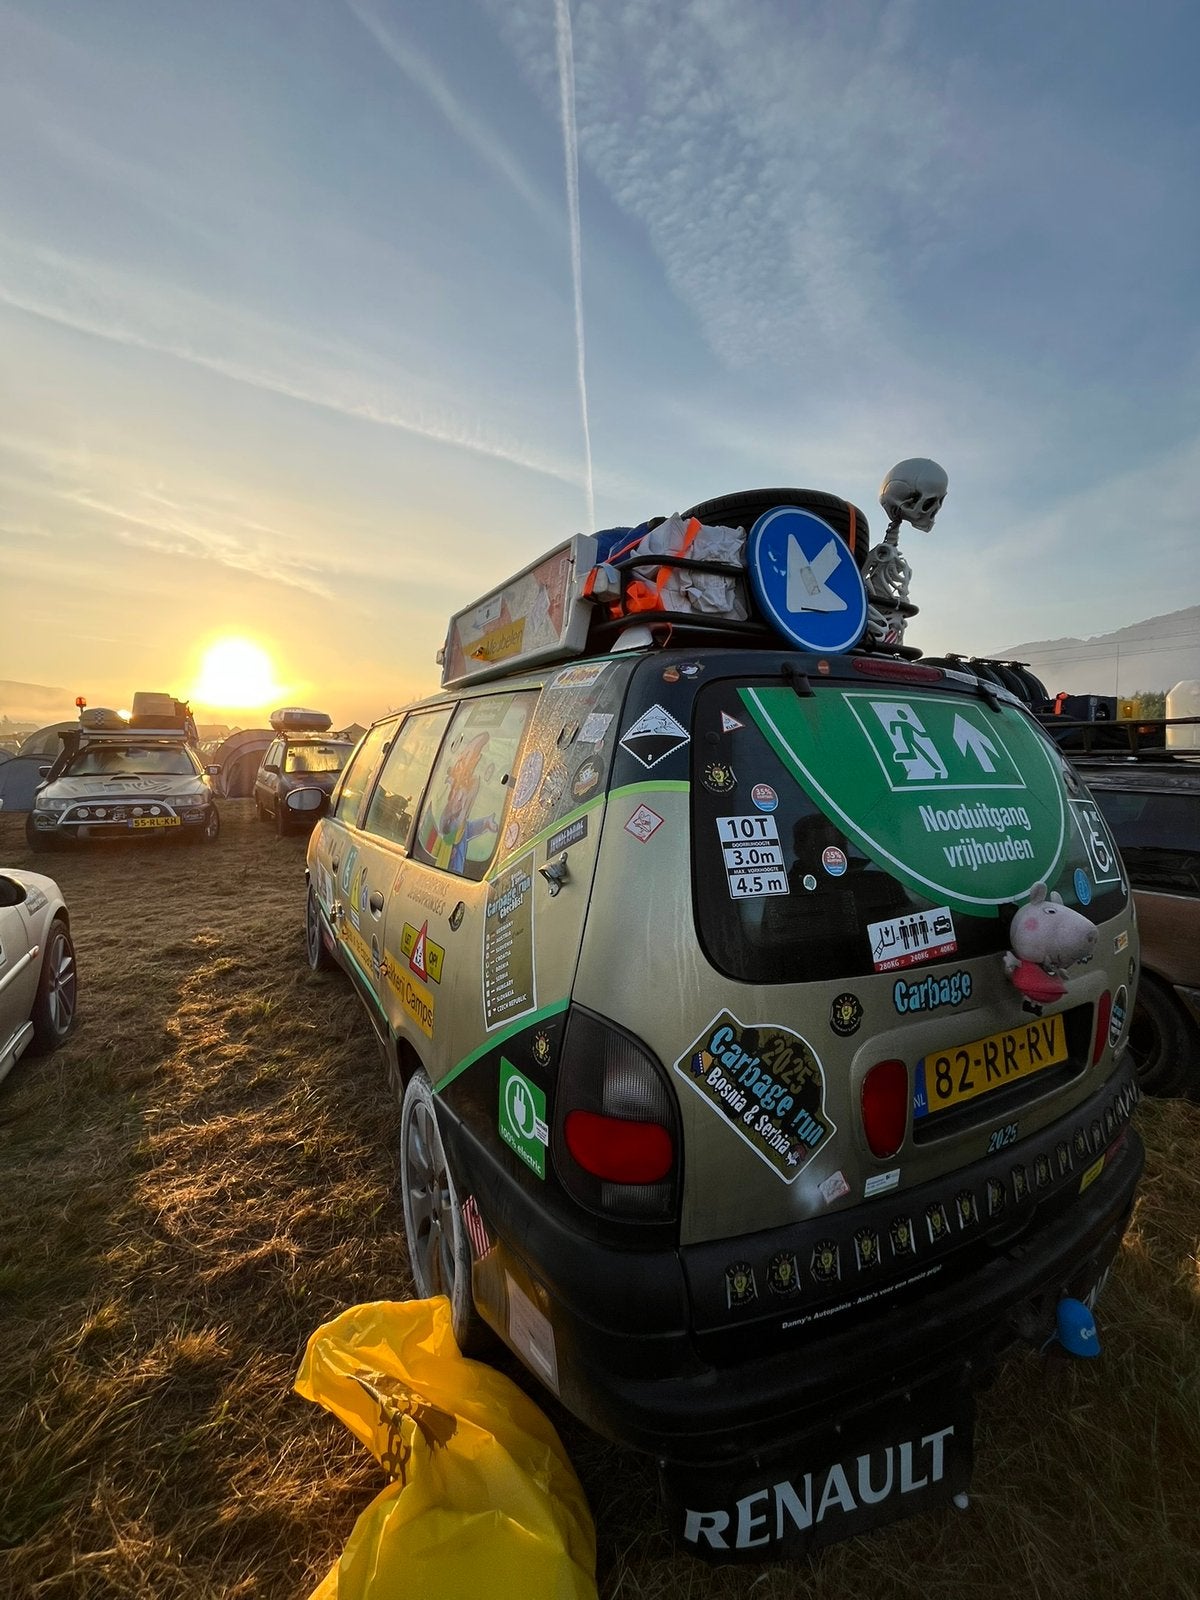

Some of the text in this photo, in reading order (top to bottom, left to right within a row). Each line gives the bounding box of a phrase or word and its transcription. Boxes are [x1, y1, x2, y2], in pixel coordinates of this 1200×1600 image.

[727, 818, 768, 839] 10T
[918, 802, 1032, 832] Nooduitgang
[732, 849, 775, 866] 3.0m
[942, 834, 1035, 872] vrijhouden
[736, 877, 783, 893] 4.5 m
[879, 959, 900, 971] 280KG
[406, 982, 433, 1027] Camps
[894, 972, 971, 1013] Carbage
[762, 1038, 815, 1095] 2025
[935, 1018, 1056, 1099] 82-RR-RV
[709, 1026, 824, 1146] Carbage run
[913, 1094, 926, 1109] NL
[706, 1066, 791, 1155] Bosnia & Serbia
[500, 1124, 517, 1150] 100%
[516, 1144, 542, 1175] electric
[987, 1121, 1020, 1153] 2025
[782, 1315, 812, 1330] Danny's
[683, 1424, 955, 1550] RENAULT
